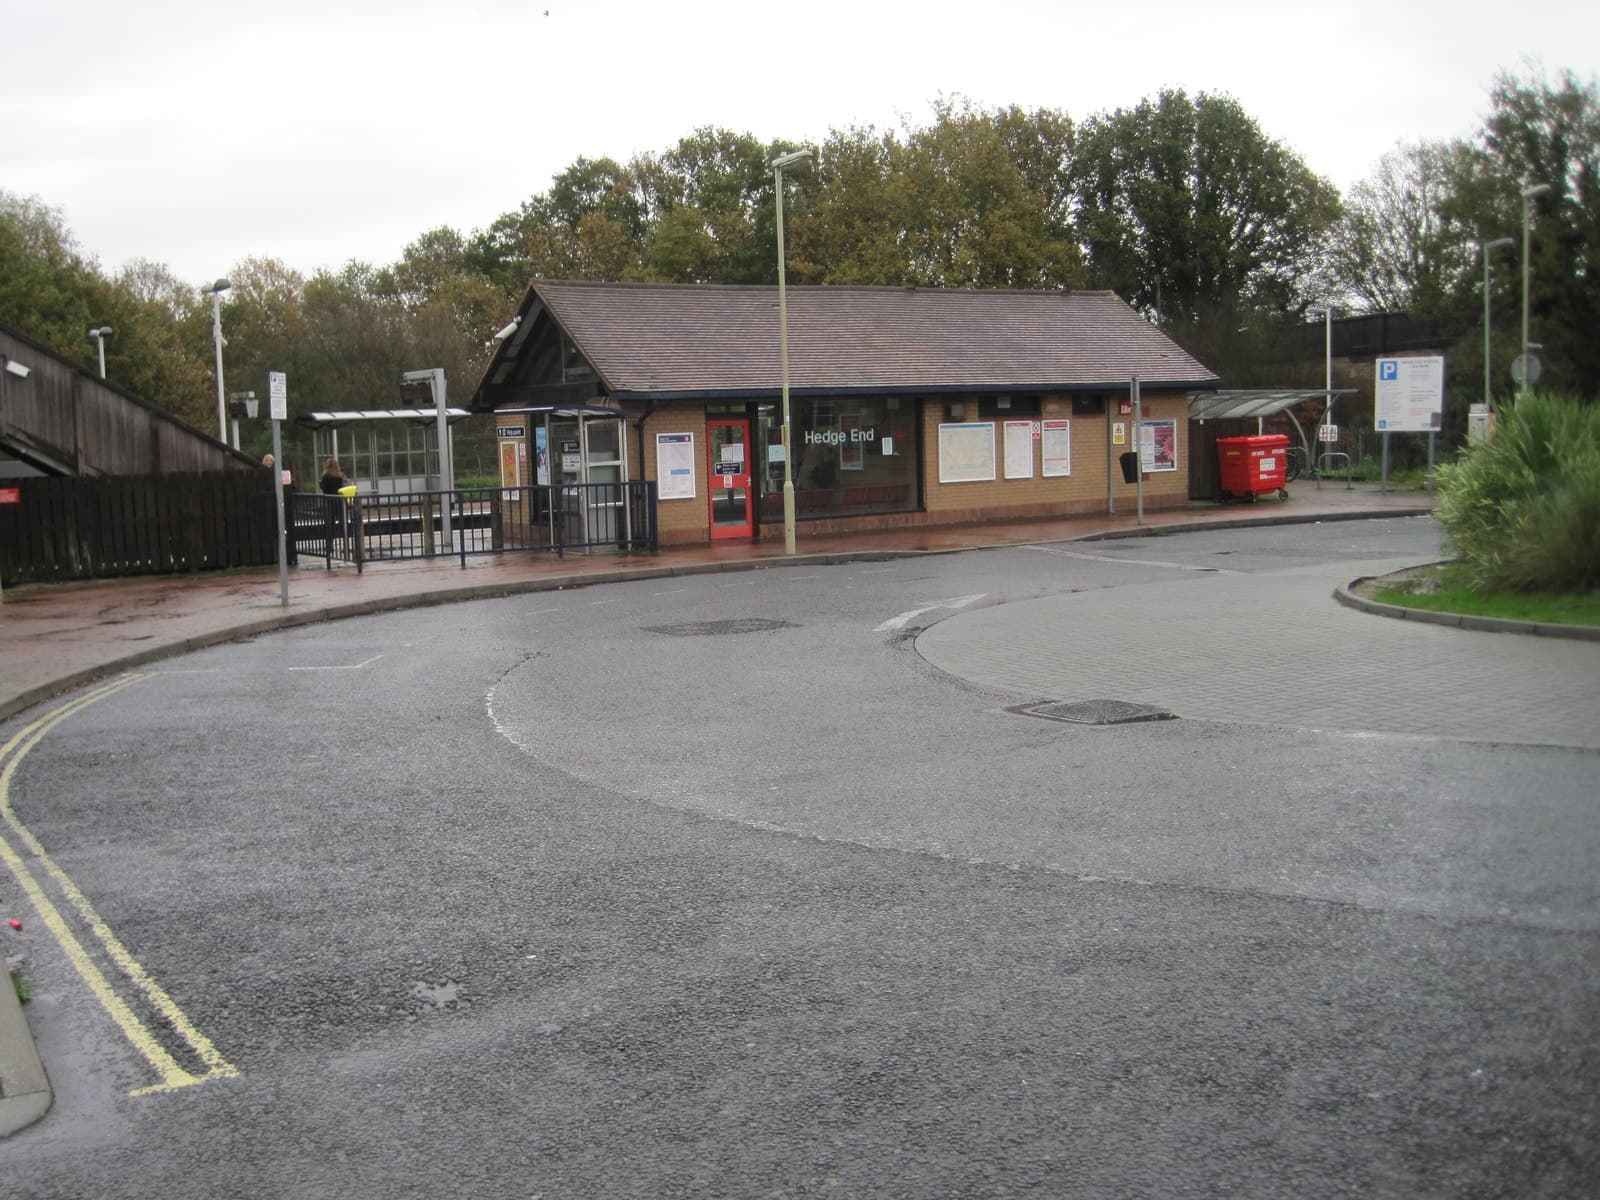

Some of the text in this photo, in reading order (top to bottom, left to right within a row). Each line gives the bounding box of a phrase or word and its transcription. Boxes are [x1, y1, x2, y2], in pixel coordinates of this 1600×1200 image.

[1383, 363, 1395, 379] P
[804, 428, 874, 445] Hedge End
